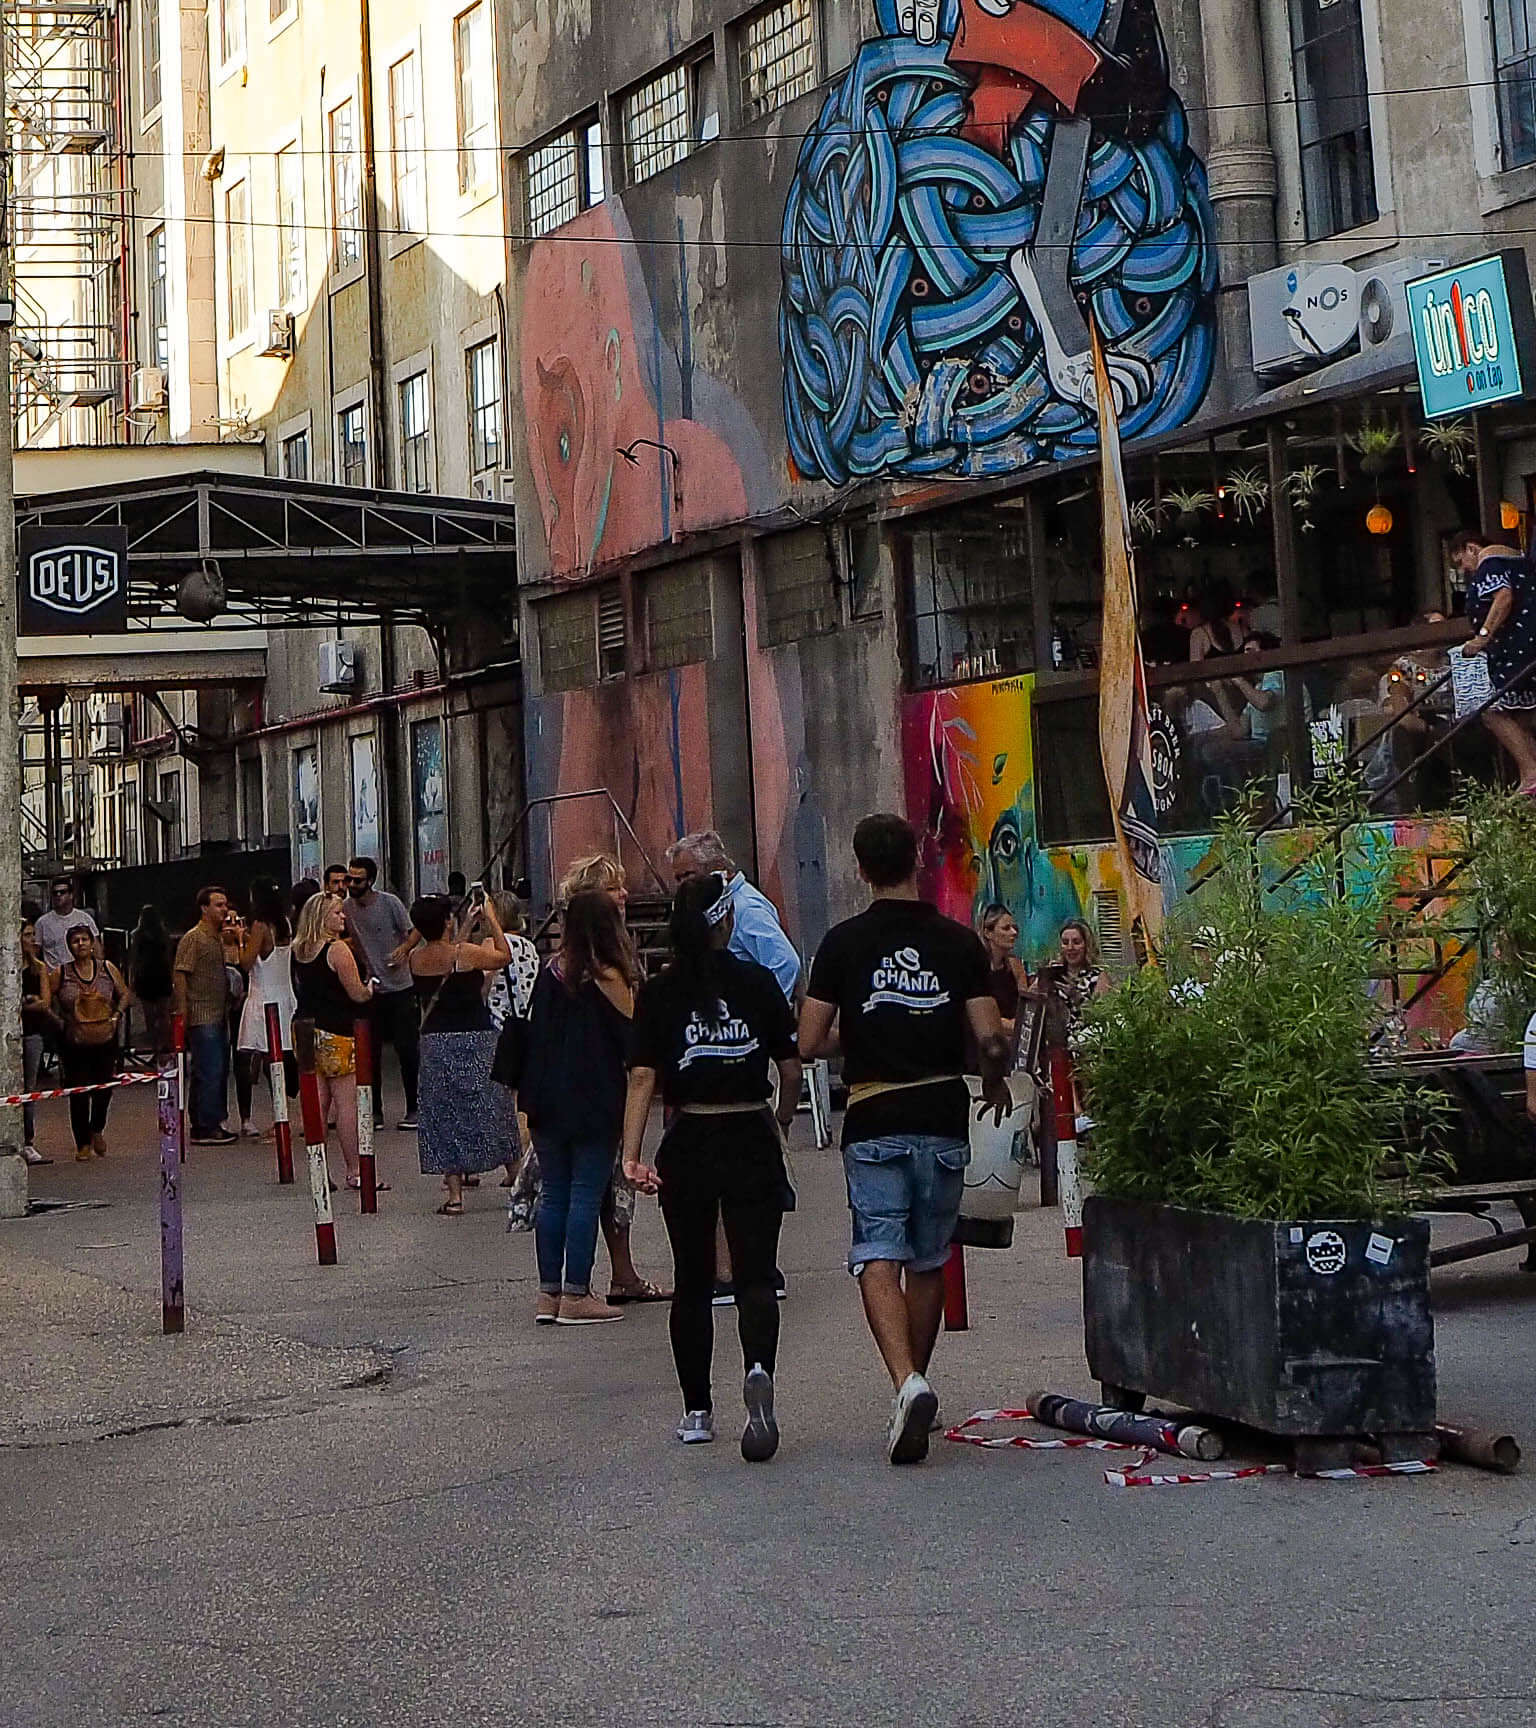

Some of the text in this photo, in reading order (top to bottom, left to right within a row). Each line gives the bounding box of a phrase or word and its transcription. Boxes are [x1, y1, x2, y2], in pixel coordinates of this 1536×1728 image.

[1307, 286, 1348, 310] NOS
[1486, 363, 1504, 391] tap
[1151, 748, 1175, 783] SBOA
[882, 956, 897, 969] EL
[873, 968, 941, 992] CHANTA
[685, 1018, 750, 1045] CHANTA
